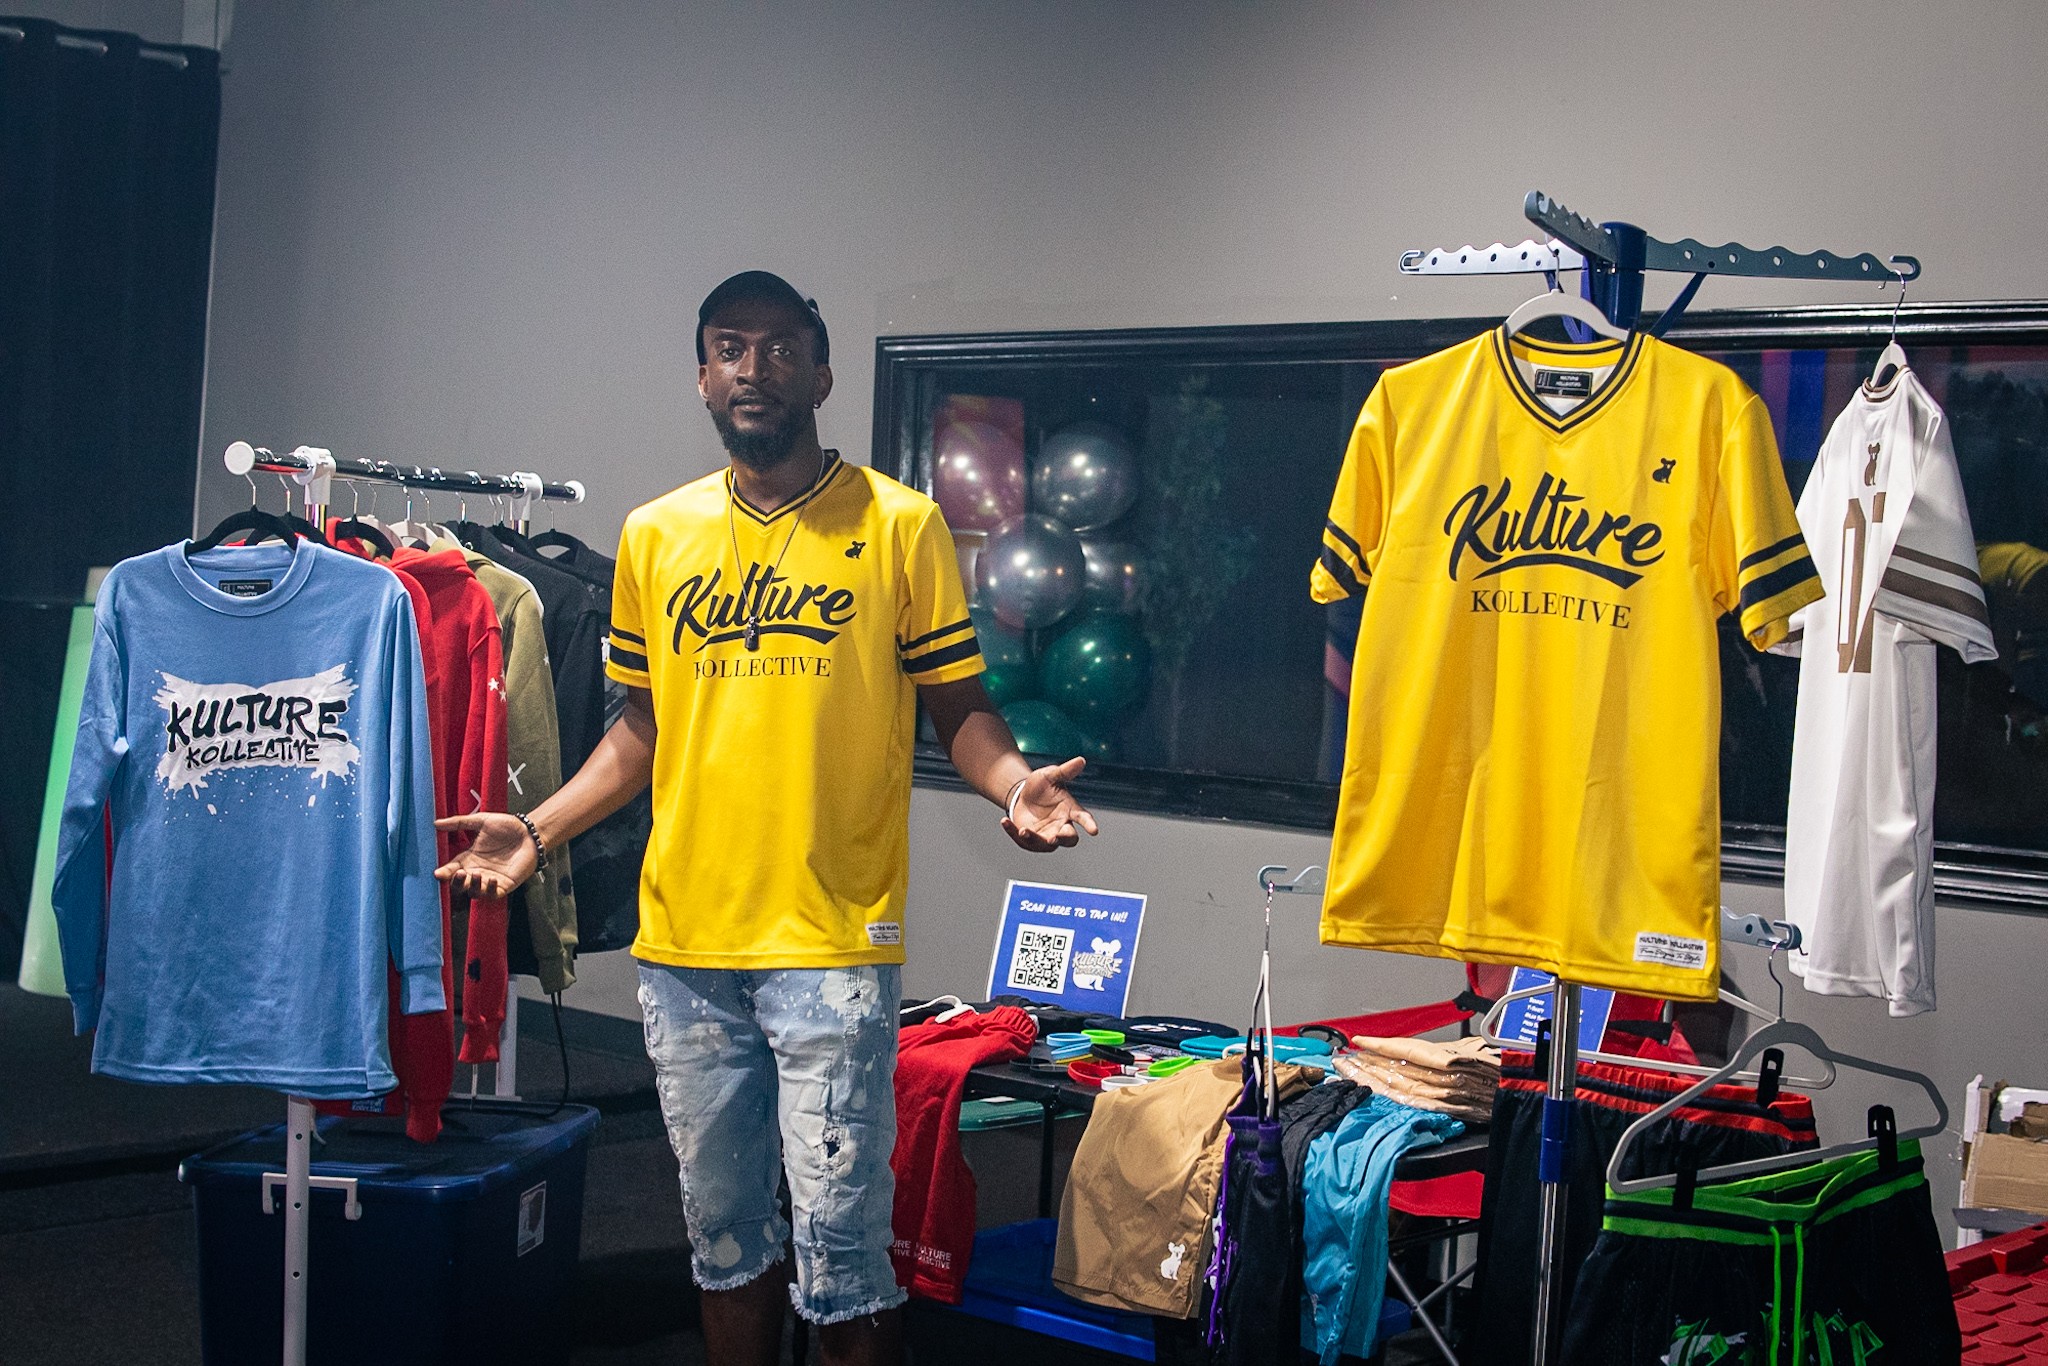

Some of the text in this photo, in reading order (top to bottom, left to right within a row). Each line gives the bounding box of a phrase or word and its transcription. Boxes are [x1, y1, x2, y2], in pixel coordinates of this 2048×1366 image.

[1444, 471, 1666, 582] Kulture
[666, 561, 857, 655] Kulture
[1471, 589, 1632, 629] KOLLETIVE
[166, 692, 348, 752] KULTURE
[1046, 904, 1072, 916] HERE
[1074, 907, 1087, 918] TO
[1090, 909, 1109, 920] TAP
